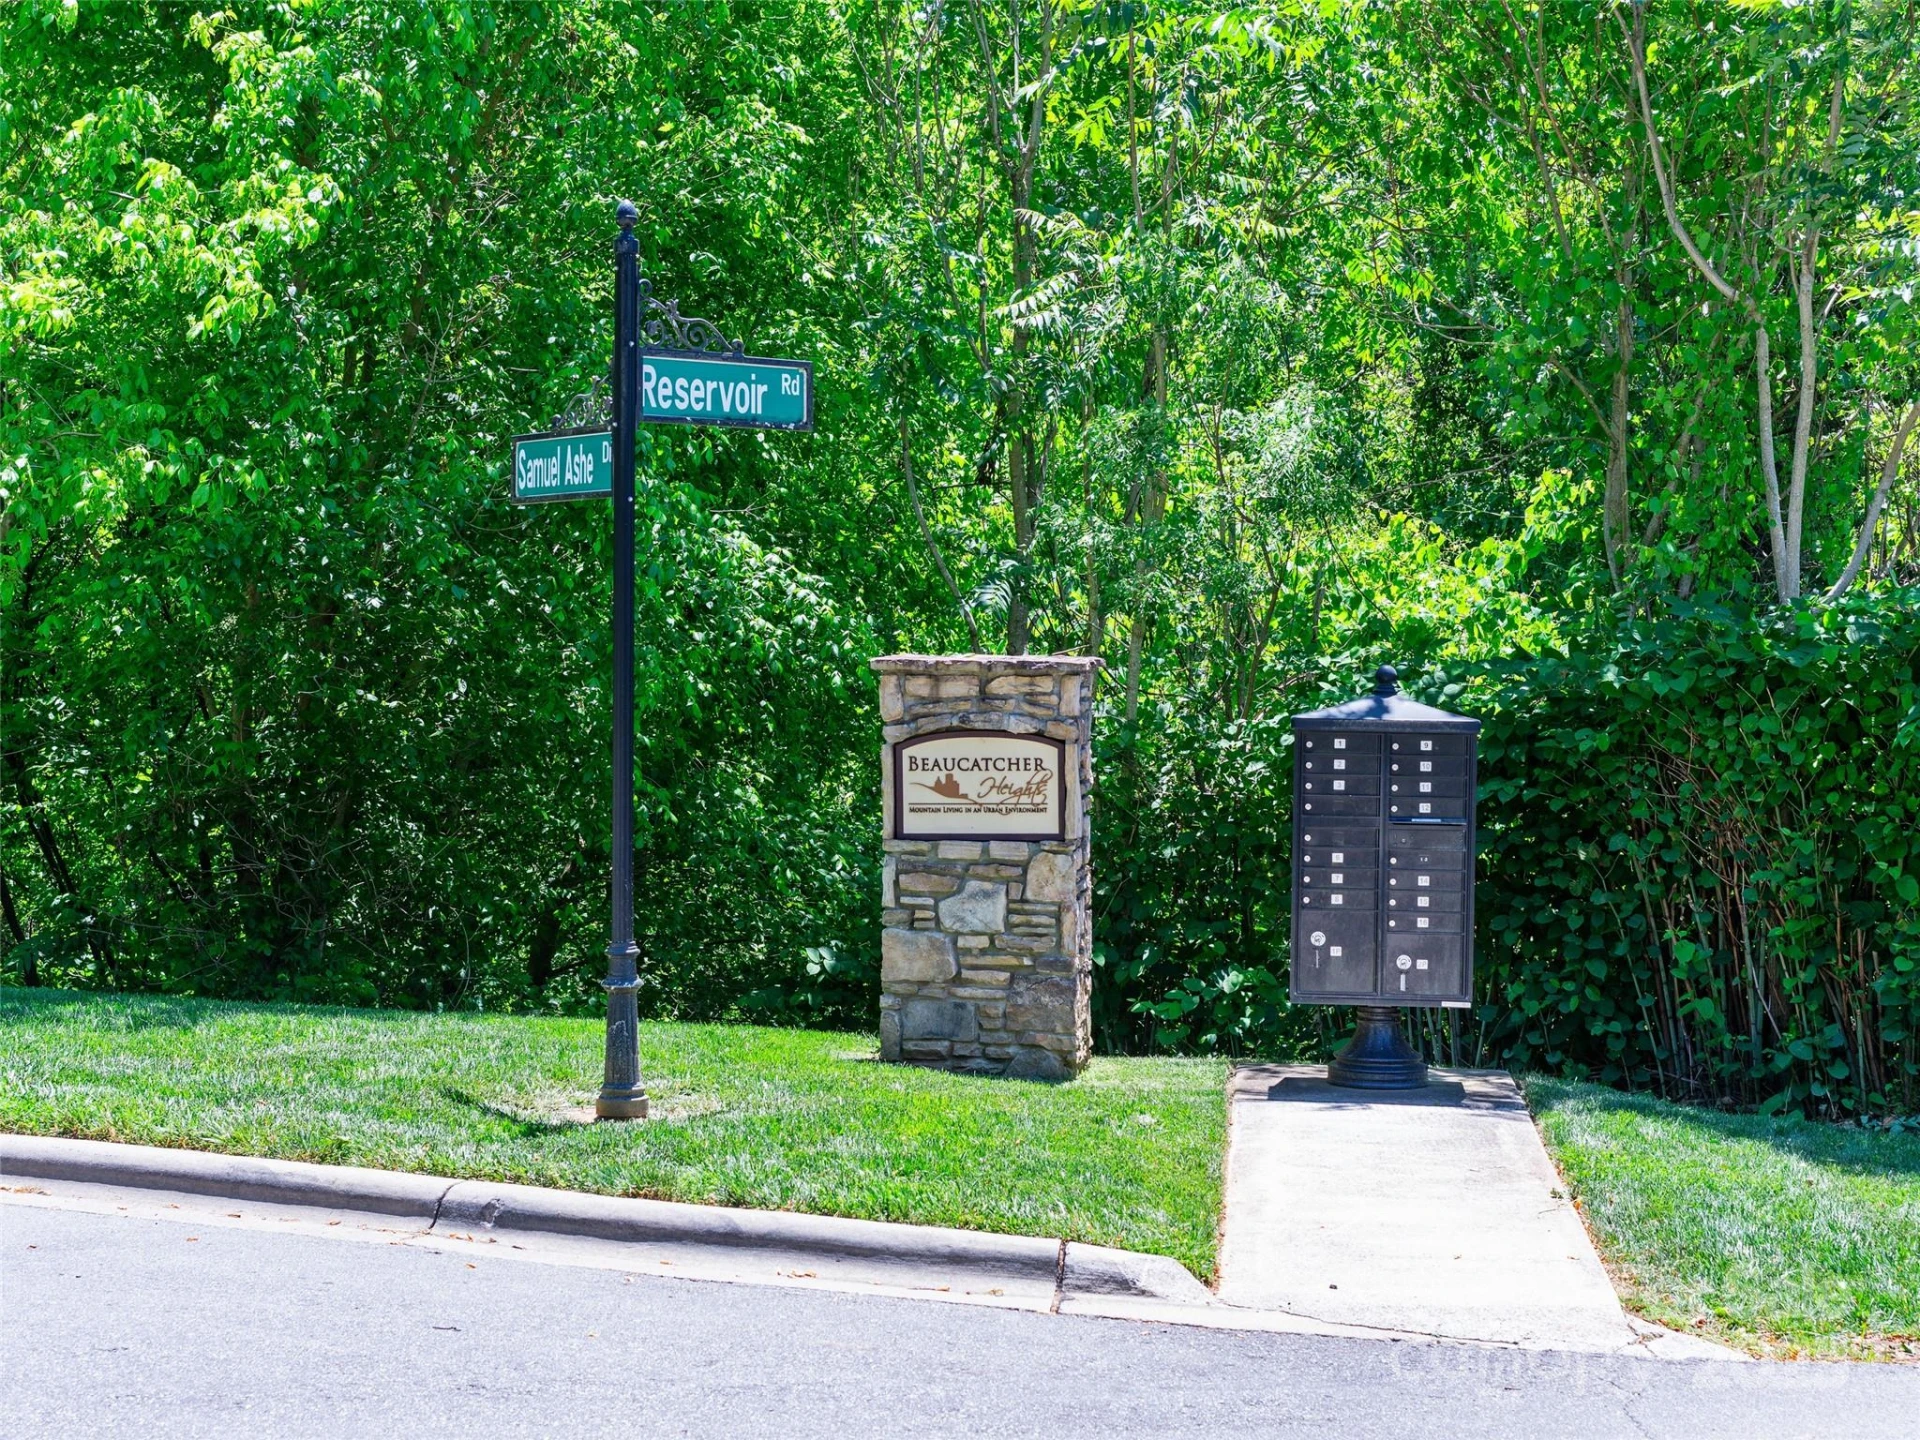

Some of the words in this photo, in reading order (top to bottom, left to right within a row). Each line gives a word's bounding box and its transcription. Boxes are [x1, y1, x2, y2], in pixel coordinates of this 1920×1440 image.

[642, 364, 768, 415] Reservoir
[781, 373, 800, 396] Rd
[518, 446, 560, 490] Samuel
[564, 443, 594, 485] Ashe
[908, 755, 1047, 772] BEAUCATCHER
[977, 769, 1053, 808] Heights
